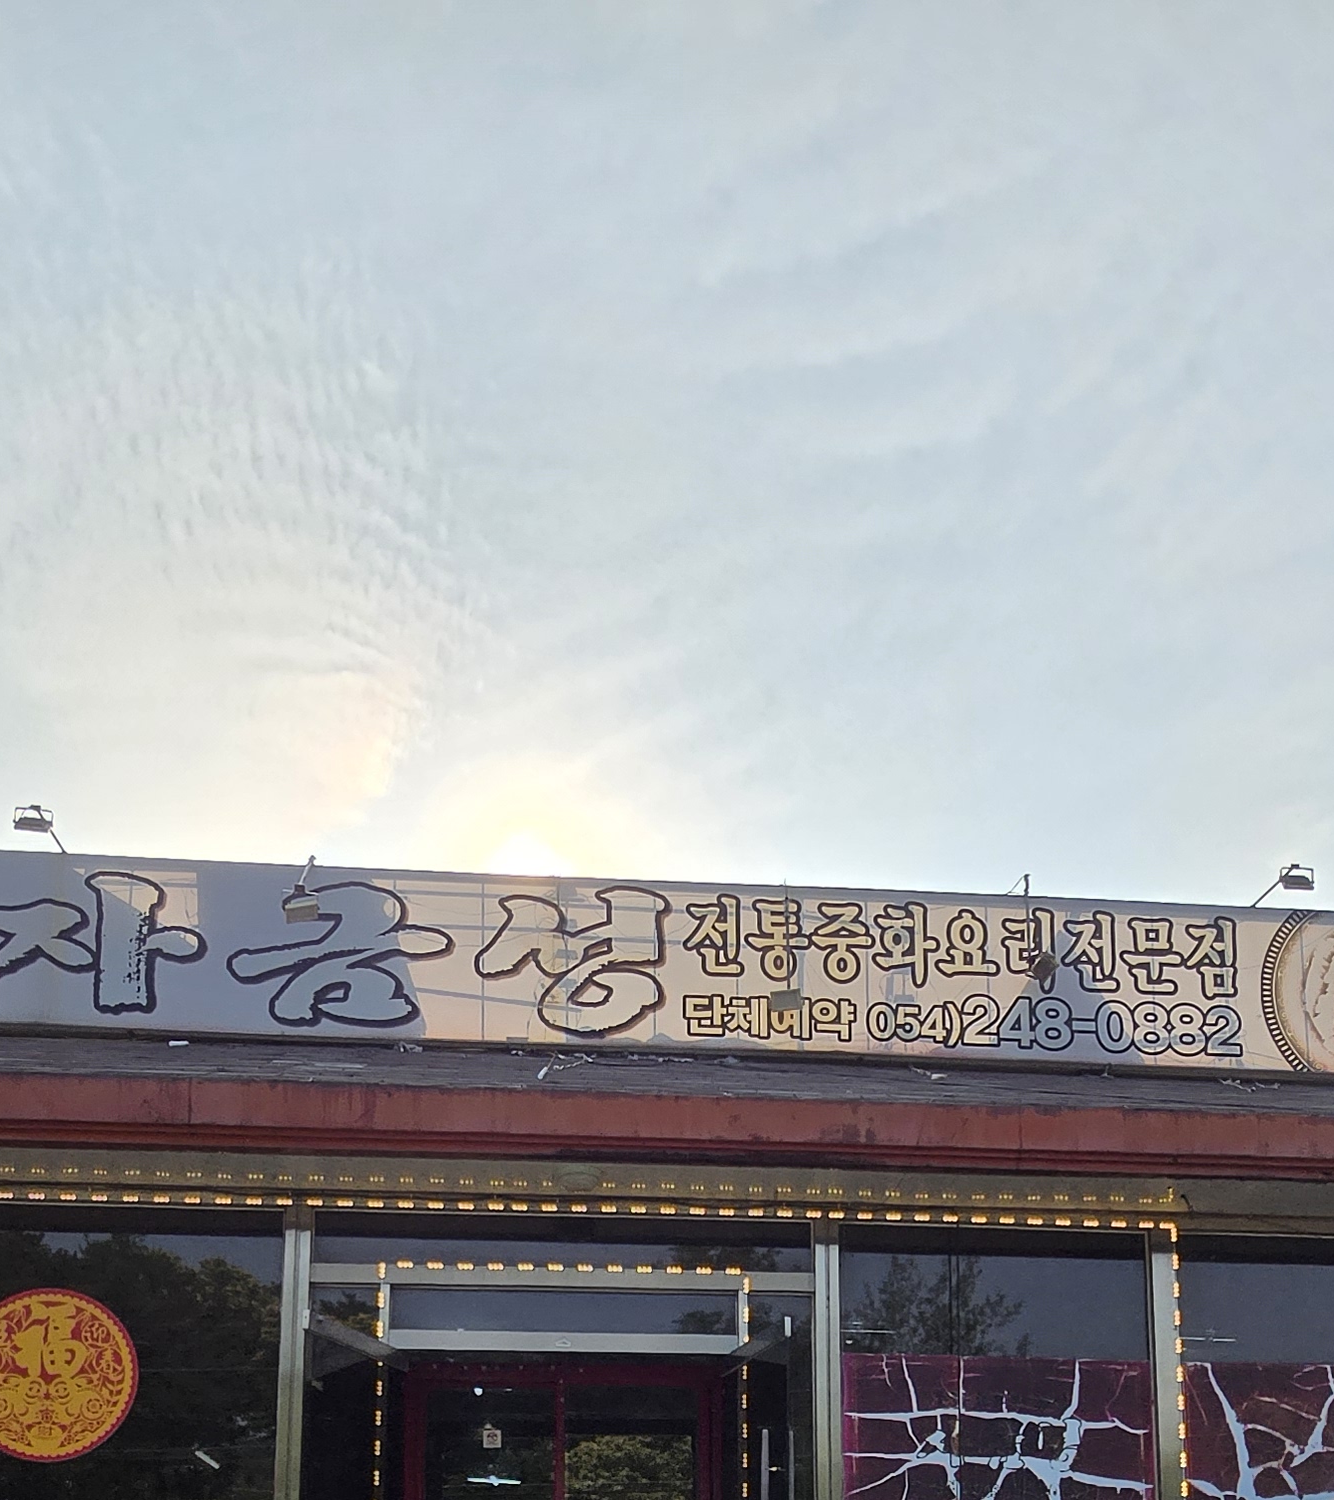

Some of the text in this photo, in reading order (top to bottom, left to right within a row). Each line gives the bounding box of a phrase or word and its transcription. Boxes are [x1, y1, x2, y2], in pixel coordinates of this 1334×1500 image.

[683, 893, 1237, 1000] 전통중화요리전문점
[683, 993, 856, 1042] 단체예약
[15, 1302, 87, 1378] 福
